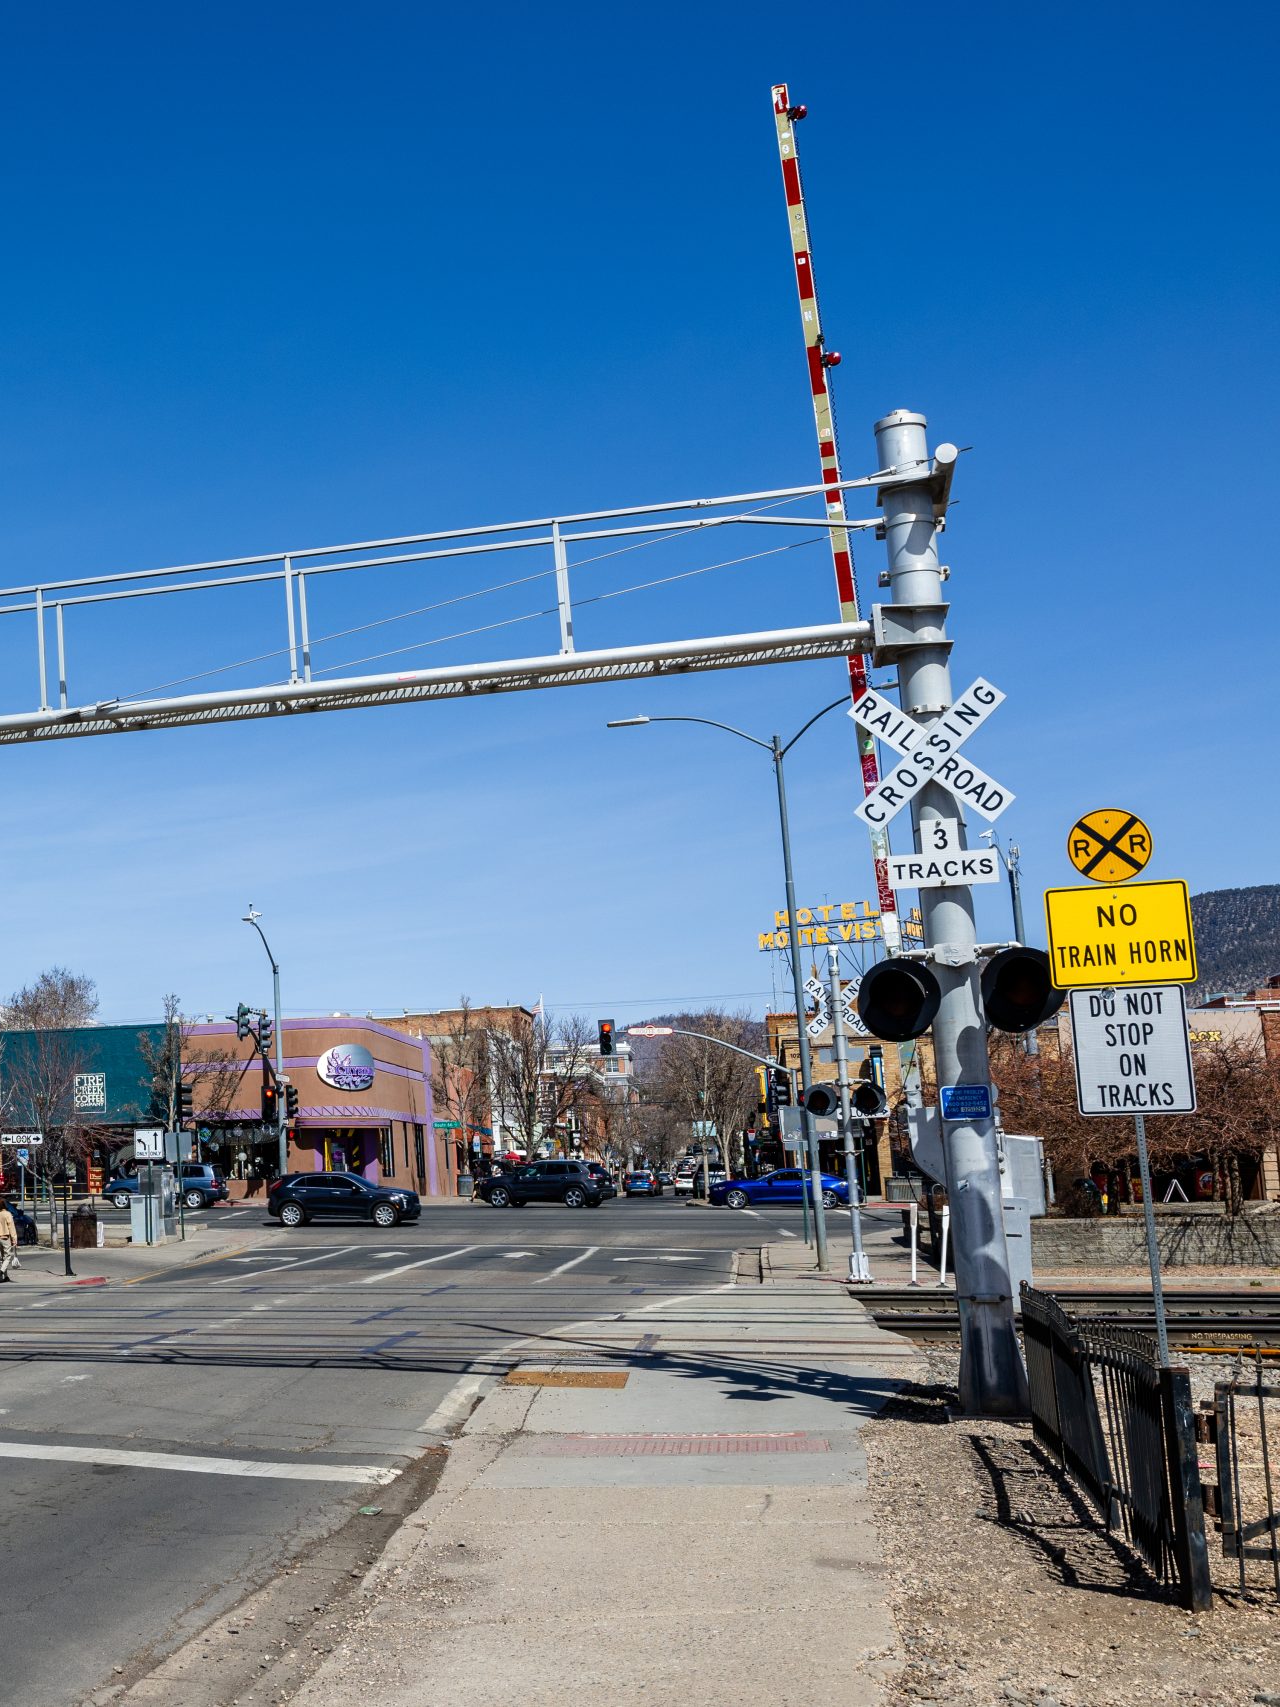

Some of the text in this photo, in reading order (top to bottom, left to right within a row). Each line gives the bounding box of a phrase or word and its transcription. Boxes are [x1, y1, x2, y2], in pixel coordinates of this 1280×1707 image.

[854, 696, 1004, 812] RAIL ROAD
[863, 685, 996, 823] CROSSING
[933, 828, 948, 850] 3
[1073, 834, 1148, 858] R R
[893, 858, 994, 880] TRACKS
[774, 901, 880, 927] HOTEL
[1096, 903, 1137, 928] NO
[1057, 939, 1188, 968] TRAIN HORN
[1089, 991, 1164, 1018] DO NOT
[841, 1006, 868, 1033] ROAD
[1105, 1022, 1154, 1047] STOP
[1119, 1053, 1147, 1077] ON
[75, 1075, 104, 1086] FIRE
[75, 1086, 104, 1095] CREEK
[75, 1095, 105, 1103] COFFEE
[1097, 1082, 1175, 1108] TRACKS
[11, 1135, 31, 1144] LOOK
